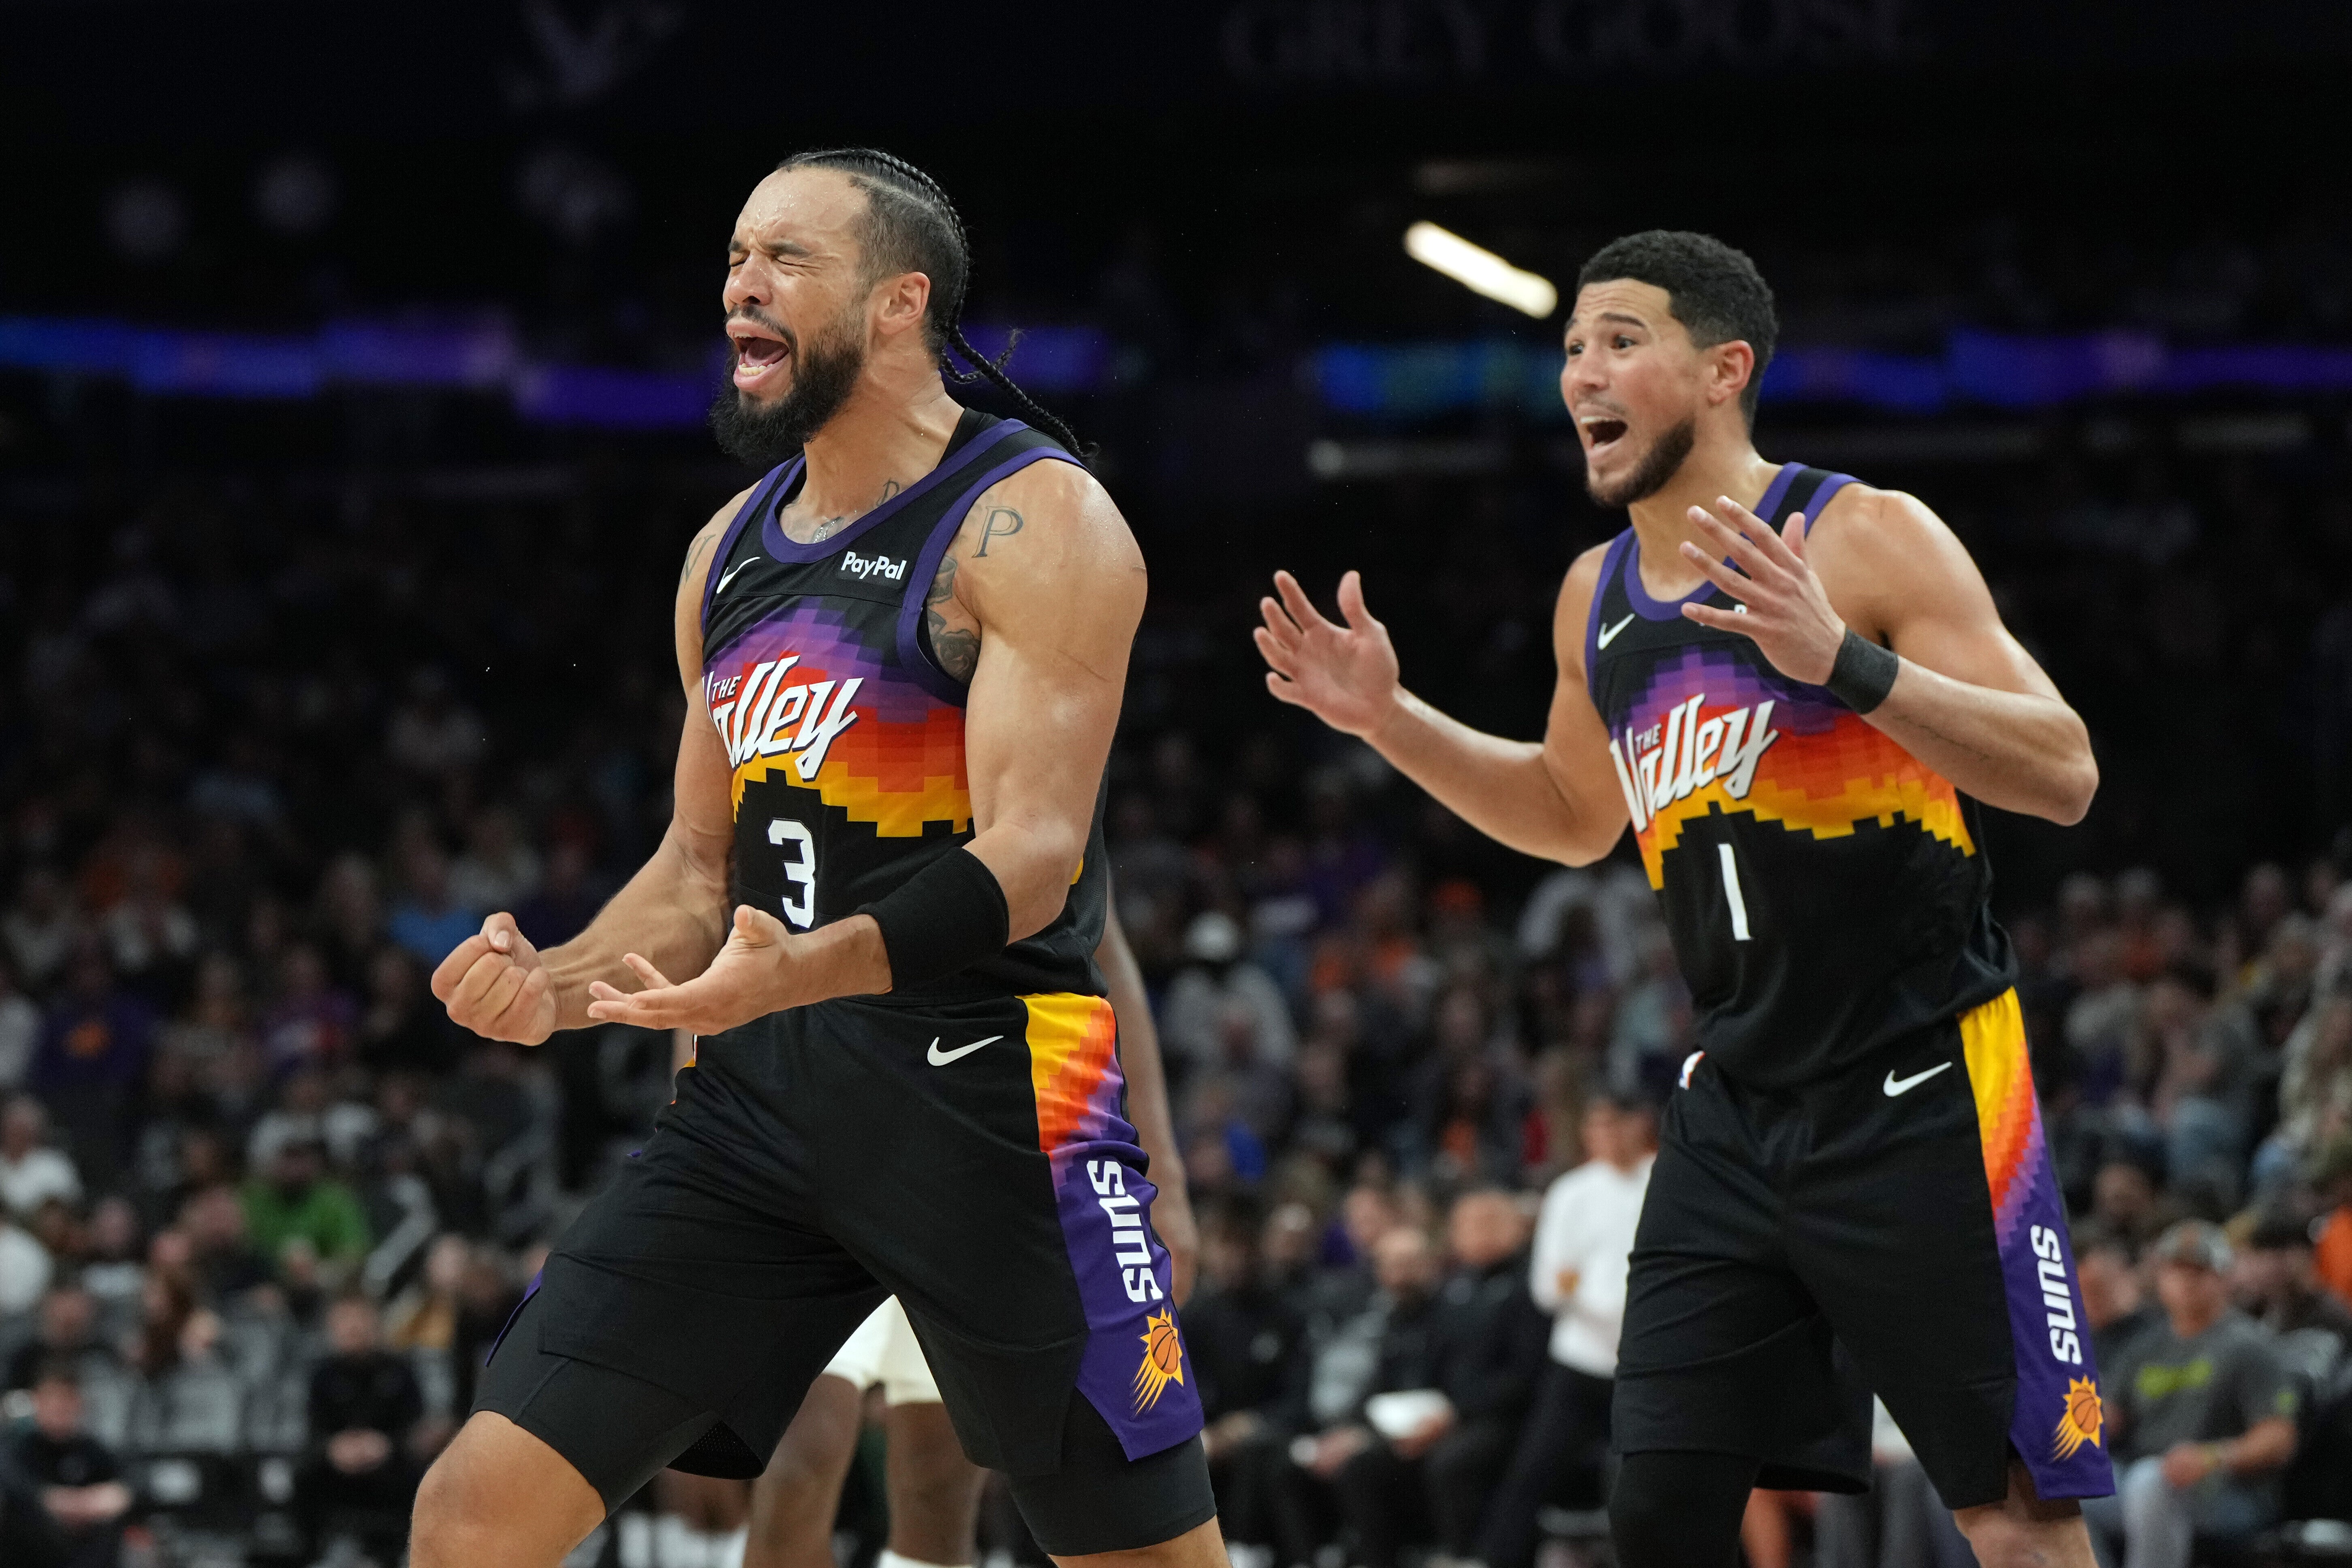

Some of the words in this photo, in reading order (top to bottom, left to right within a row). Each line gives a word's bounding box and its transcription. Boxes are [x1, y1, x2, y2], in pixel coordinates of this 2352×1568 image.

[841, 551, 907, 580] PayPal
[712, 675, 742, 702] THE
[1609, 693, 1779, 833] Valley
[1635, 723, 1662, 754] THE
[767, 818, 816, 929] 3
[1718, 843, 1751, 941] 1
